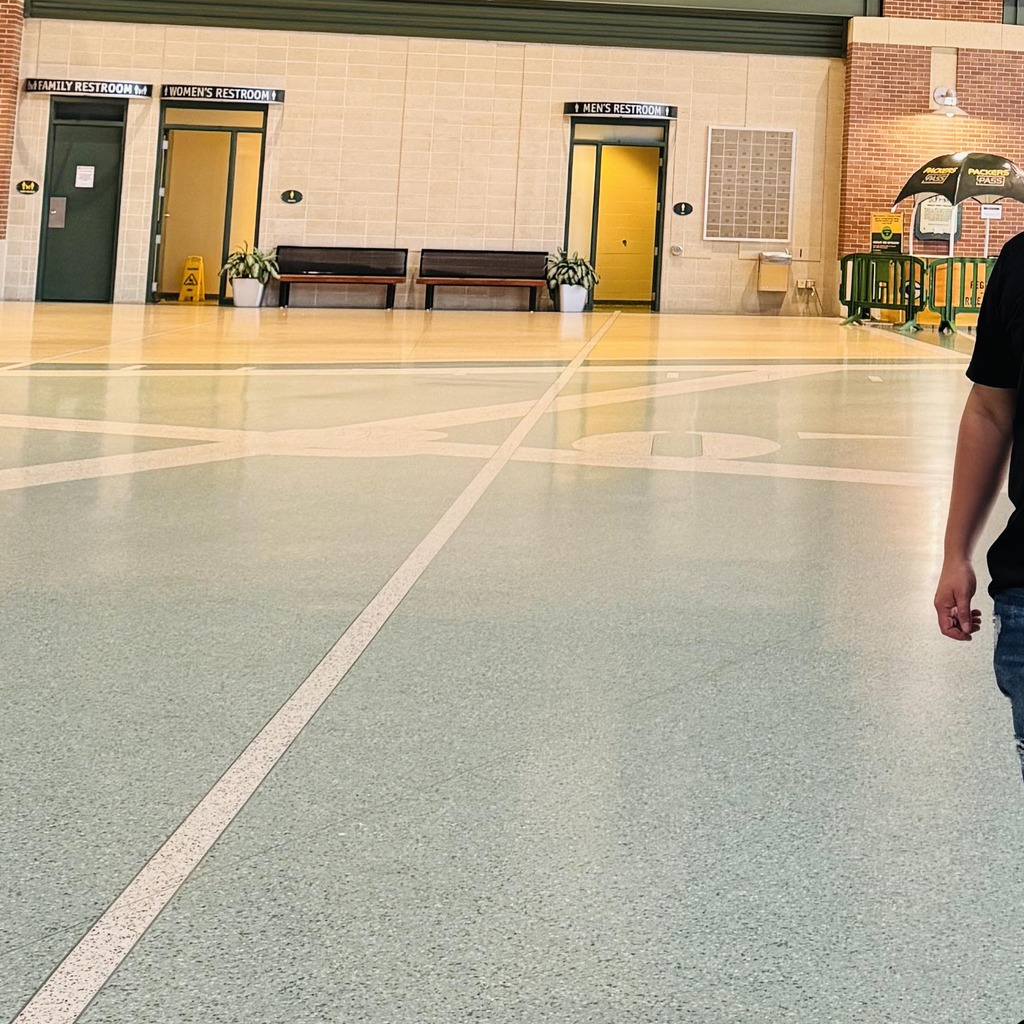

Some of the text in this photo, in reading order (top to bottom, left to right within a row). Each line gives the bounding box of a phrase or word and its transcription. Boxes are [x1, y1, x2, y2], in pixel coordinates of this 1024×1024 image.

[38, 80, 132, 94] FAMILY RESTROOM
[169, 86, 270, 100] WOMEN'S RESTROOM
[583, 103, 662, 116] MEN'S RESTROOM
[968, 168, 1010, 176] PACKERS
[979, 176, 1003, 184] PASS
